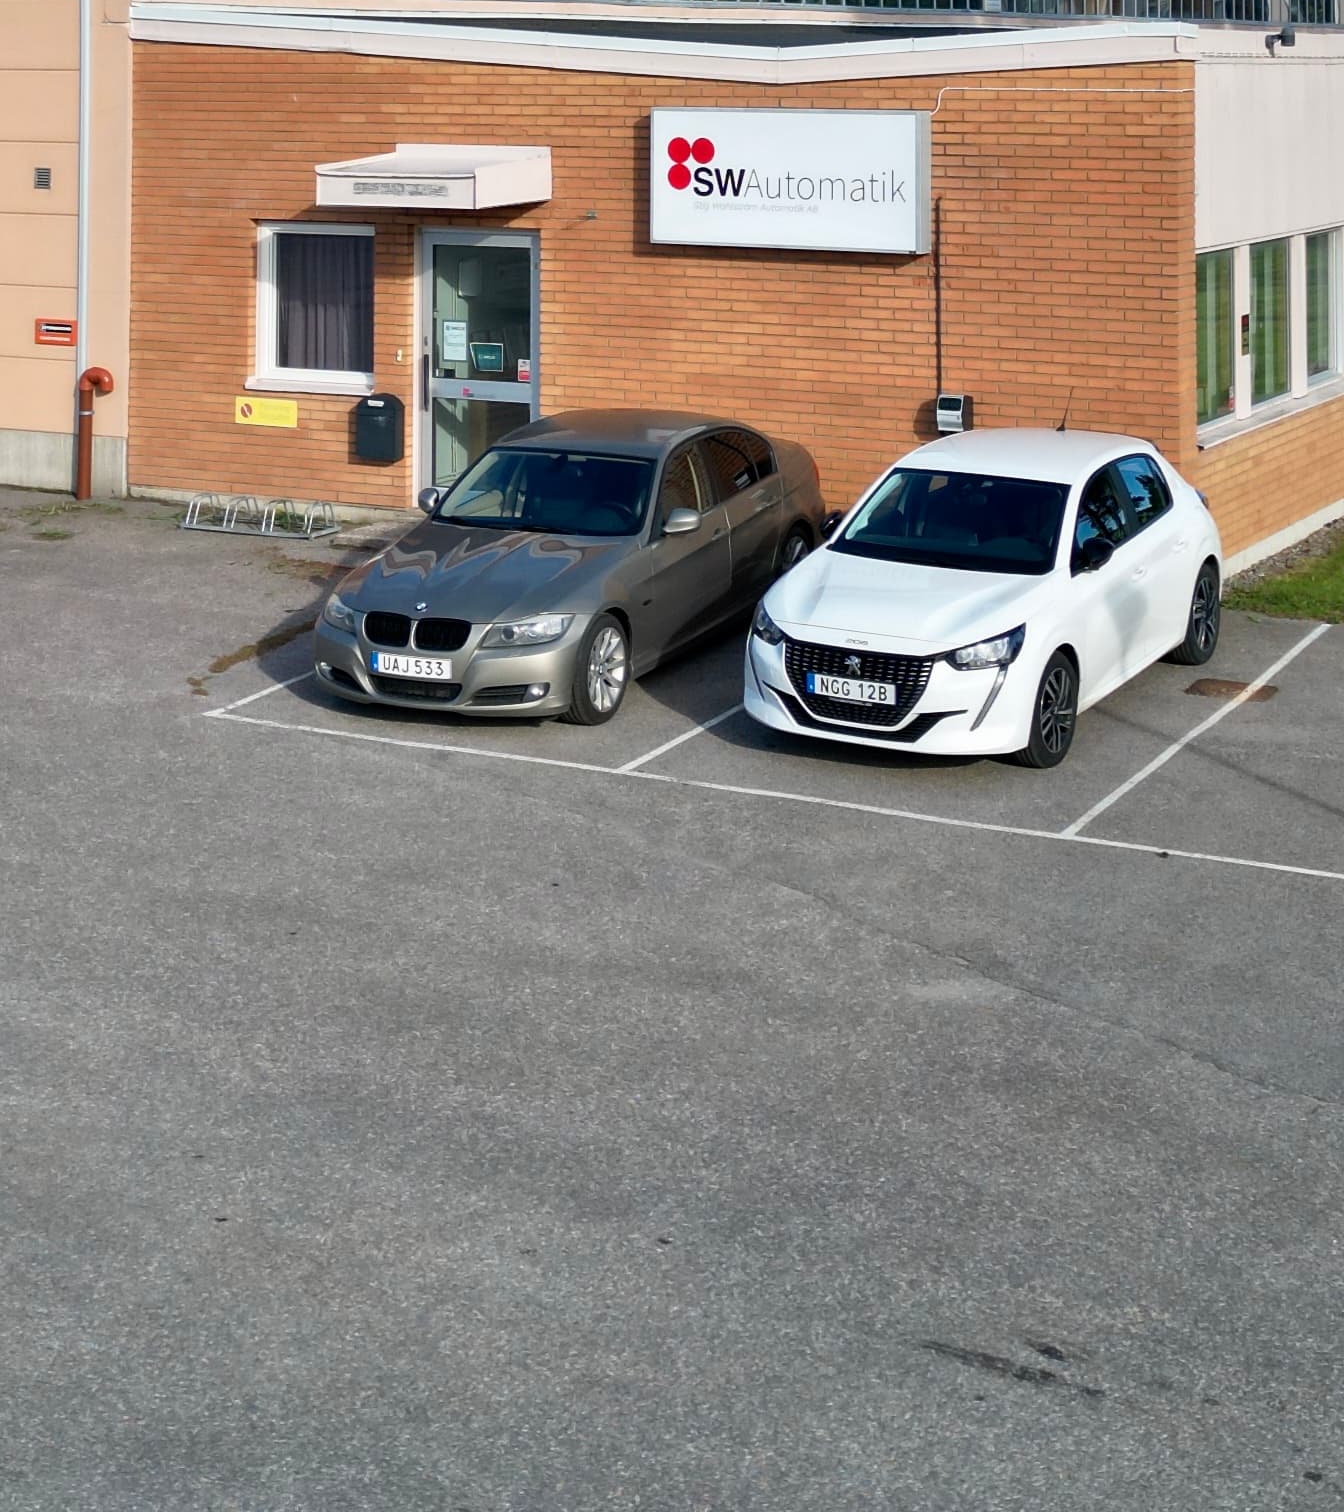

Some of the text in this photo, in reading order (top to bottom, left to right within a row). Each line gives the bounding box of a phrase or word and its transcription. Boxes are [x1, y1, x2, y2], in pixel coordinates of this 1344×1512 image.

[693, 166, 907, 203] SWAutomatik
[383, 655, 444, 677] UAJ 533
[820, 677, 888, 702] NGG 12B
